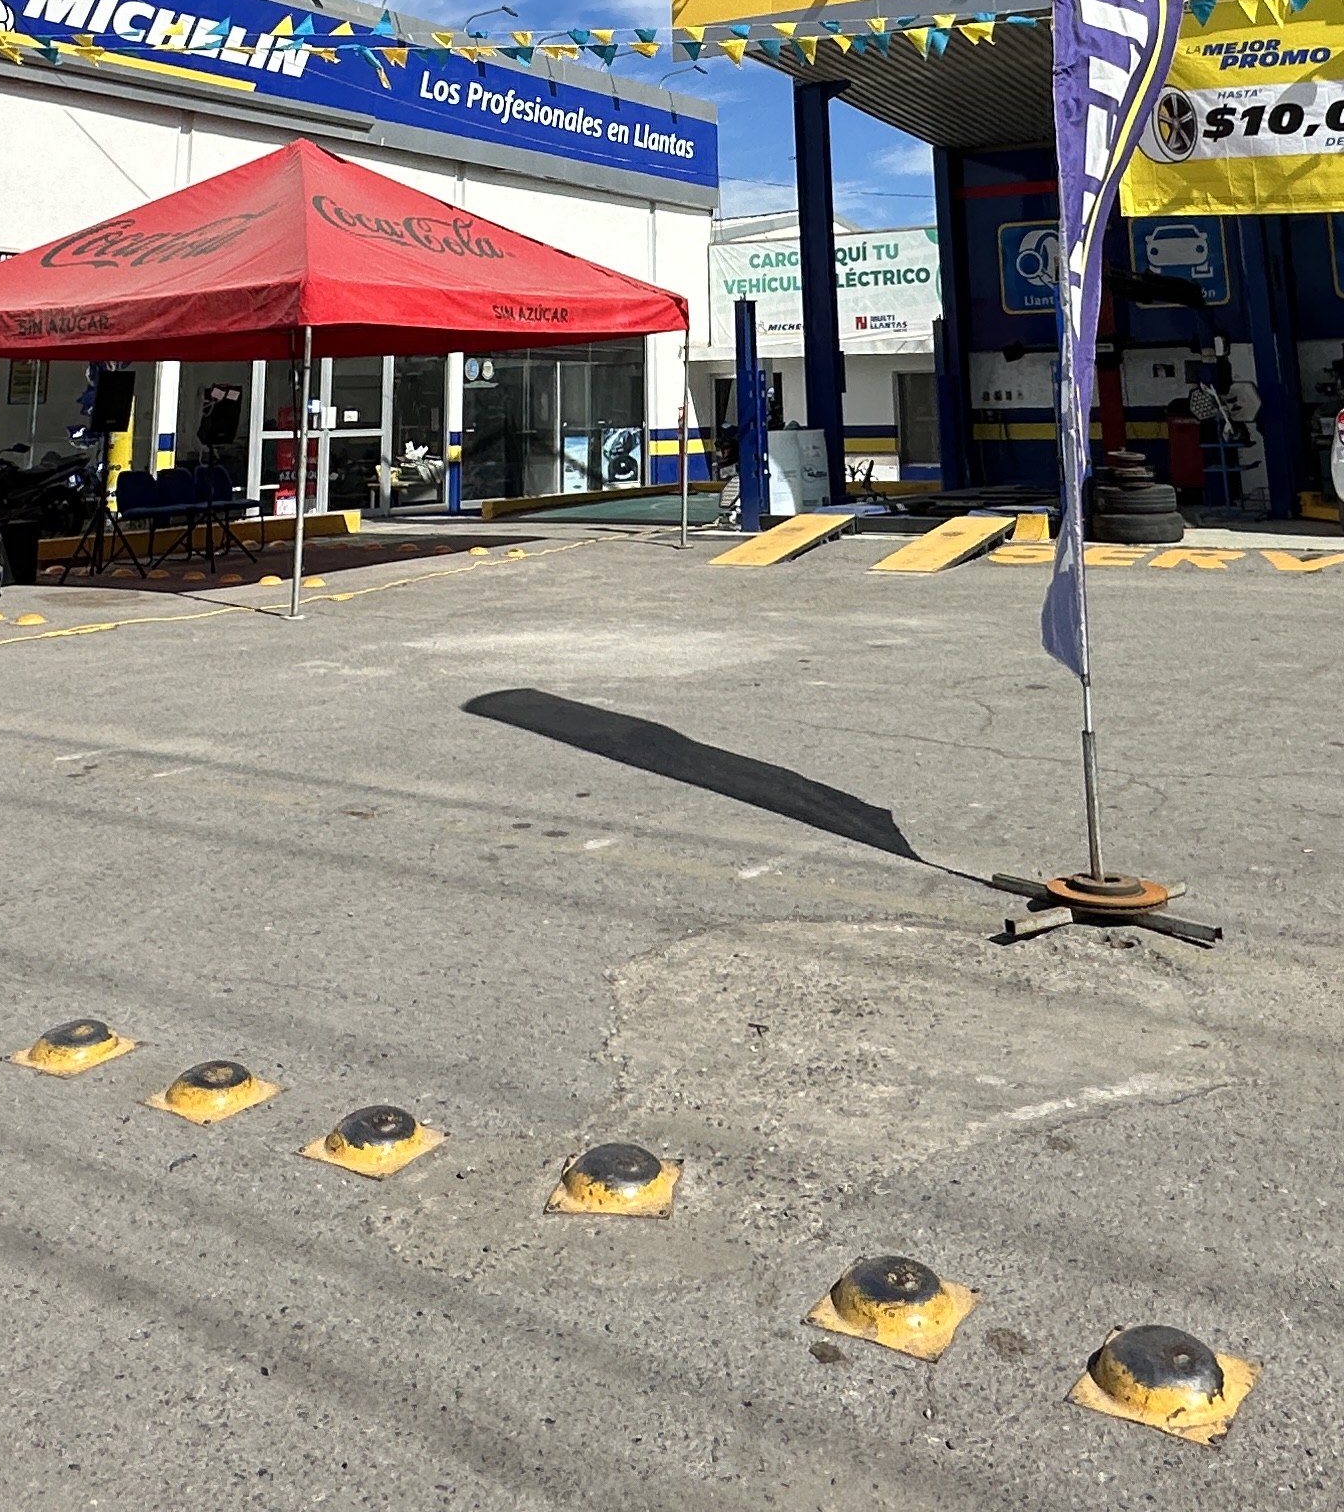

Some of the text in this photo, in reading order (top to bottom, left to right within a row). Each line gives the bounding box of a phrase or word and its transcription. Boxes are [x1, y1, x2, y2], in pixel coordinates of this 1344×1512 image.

[1185, 38, 1282, 56] LA MEJOR
[1219, 46, 1332, 71] PROMO
[419, 69, 695, 160] Los Profesionales en Llantas
[1324, 135, 1344, 147] DE
[748, 241, 899, 269] CARG QUÍ TU
[723, 267, 931, 295] VEHÍCUL LÉCTRICO
[492, 304, 517, 322] SIN
